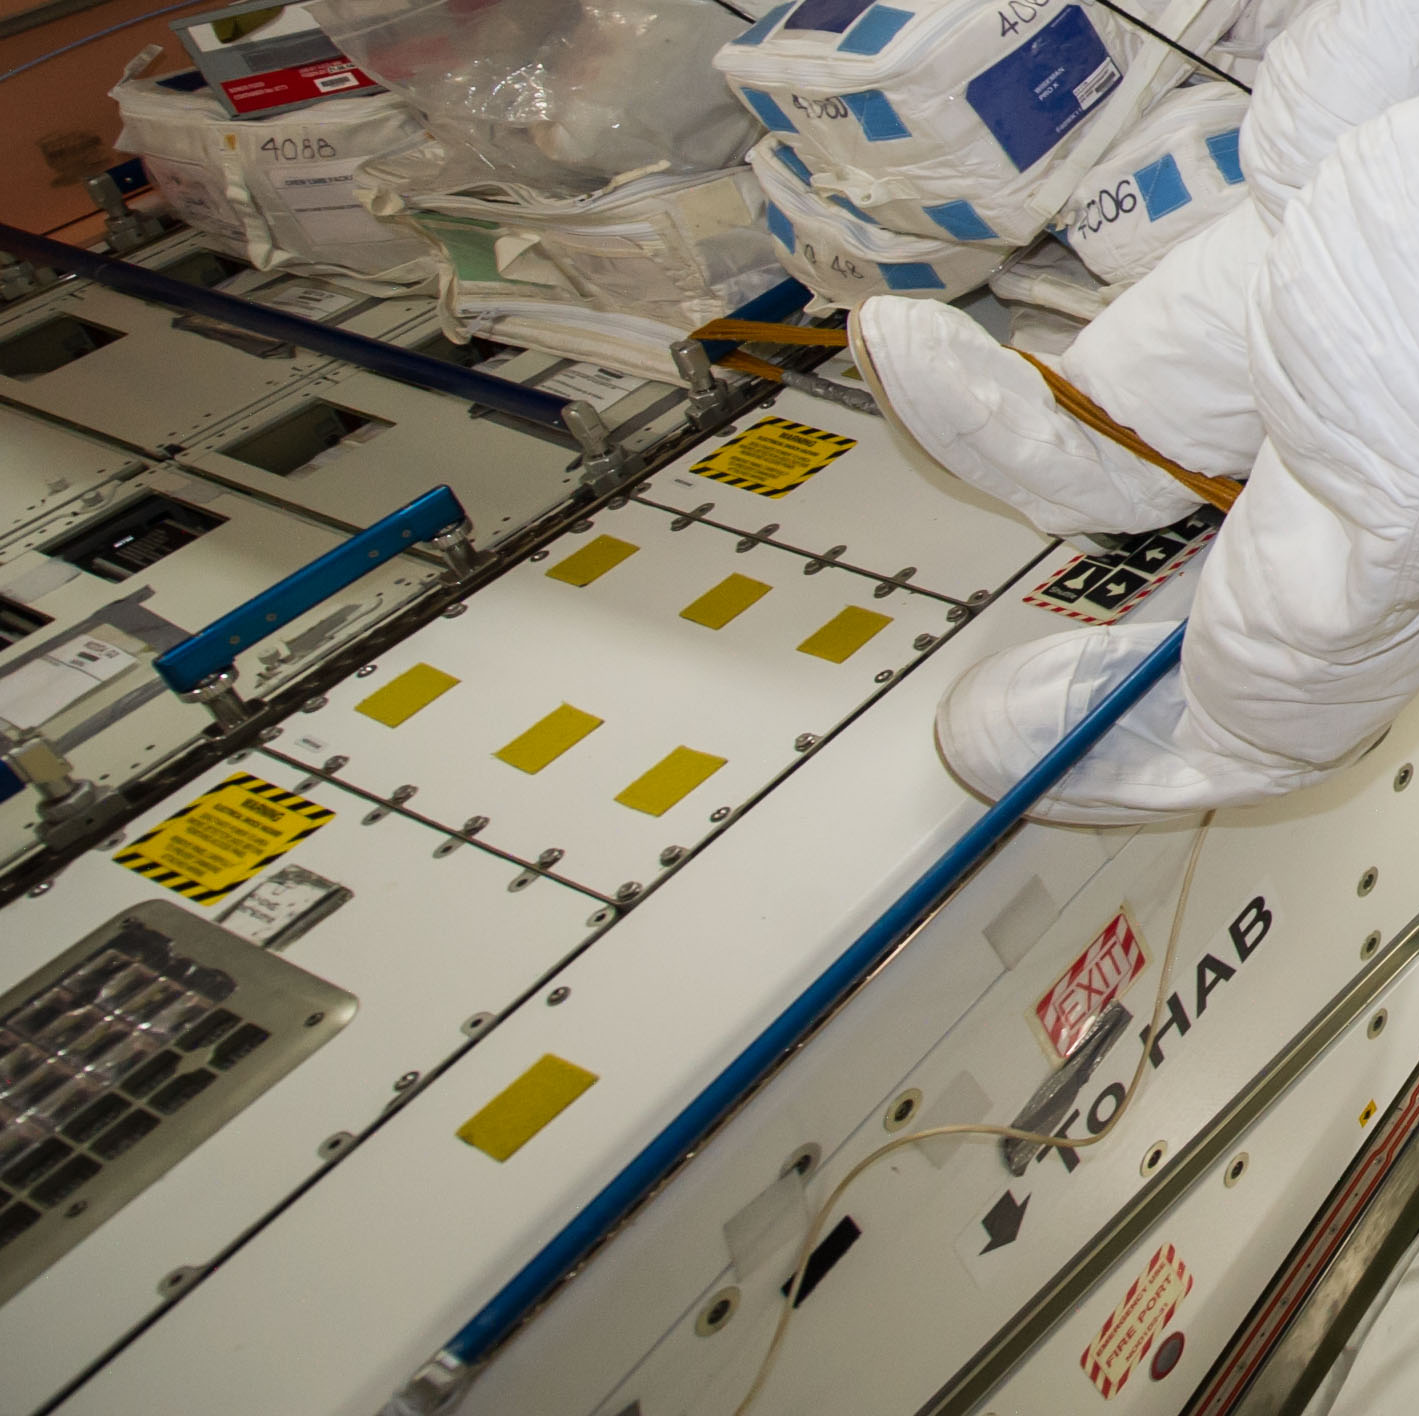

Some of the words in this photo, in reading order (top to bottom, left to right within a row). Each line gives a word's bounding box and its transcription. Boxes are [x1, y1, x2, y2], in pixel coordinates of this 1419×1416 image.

[778, 431, 818, 448] WARNING
[241, 797, 286, 823] WARNING
[1058, 943, 1136, 1034] EXIT
[1037, 1082, 1131, 1174] TO
[1138, 895, 1276, 1068] HAB
[1105, 1326, 1137, 1370] FIRE
[1138, 1276, 1174, 1325] PORT
